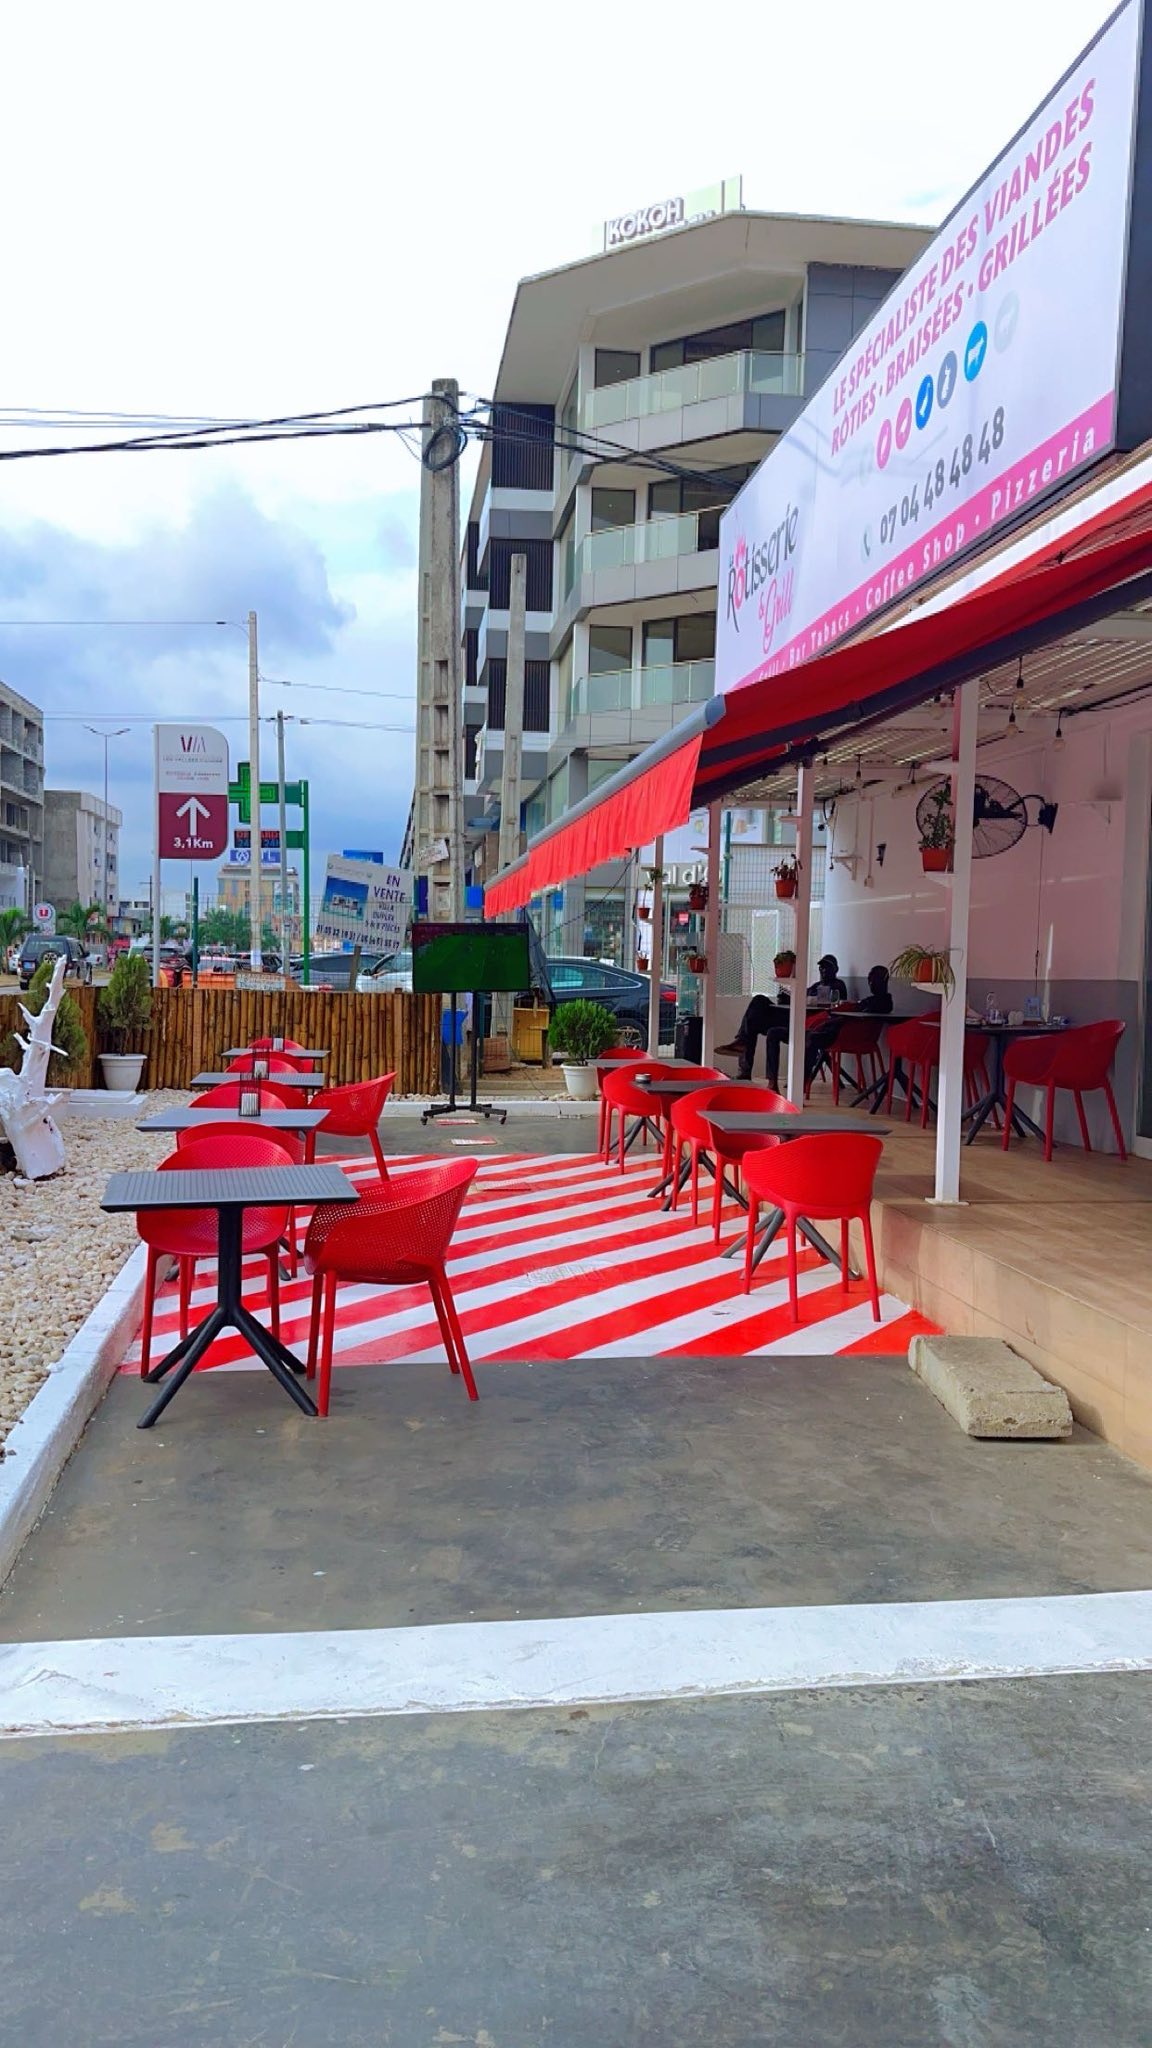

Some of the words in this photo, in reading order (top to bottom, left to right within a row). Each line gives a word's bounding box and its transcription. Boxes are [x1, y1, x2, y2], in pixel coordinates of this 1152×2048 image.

[607, 197, 684, 244] KOKOH
[833, 376, 847, 415] LE
[849, 263, 938, 398] SPÉCIALISTE
[941, 214, 978, 287] DES
[985, 78, 1096, 236] VIANDES
[832, 380, 876, 457] RÔTIES
[886, 279, 964, 396] BRAISÉES
[978, 142, 1092, 292] GRILLÉES
[880, 504, 897, 544] 07
[901, 484, 919, 527] 04
[924, 458, 945, 511] 48
[950, 433, 973, 488] 48
[978, 405, 1005, 465] 48
[789, 641, 806, 668] Bar
[811, 610, 849, 655] Tabacs
[866, 561, 914, 612] Coffee
[923, 522, 965, 570] Shop
[991, 426, 1095, 520] Pizzeria
[374, 885, 406, 903] VENTE
[386, 874, 400, 887] EN
